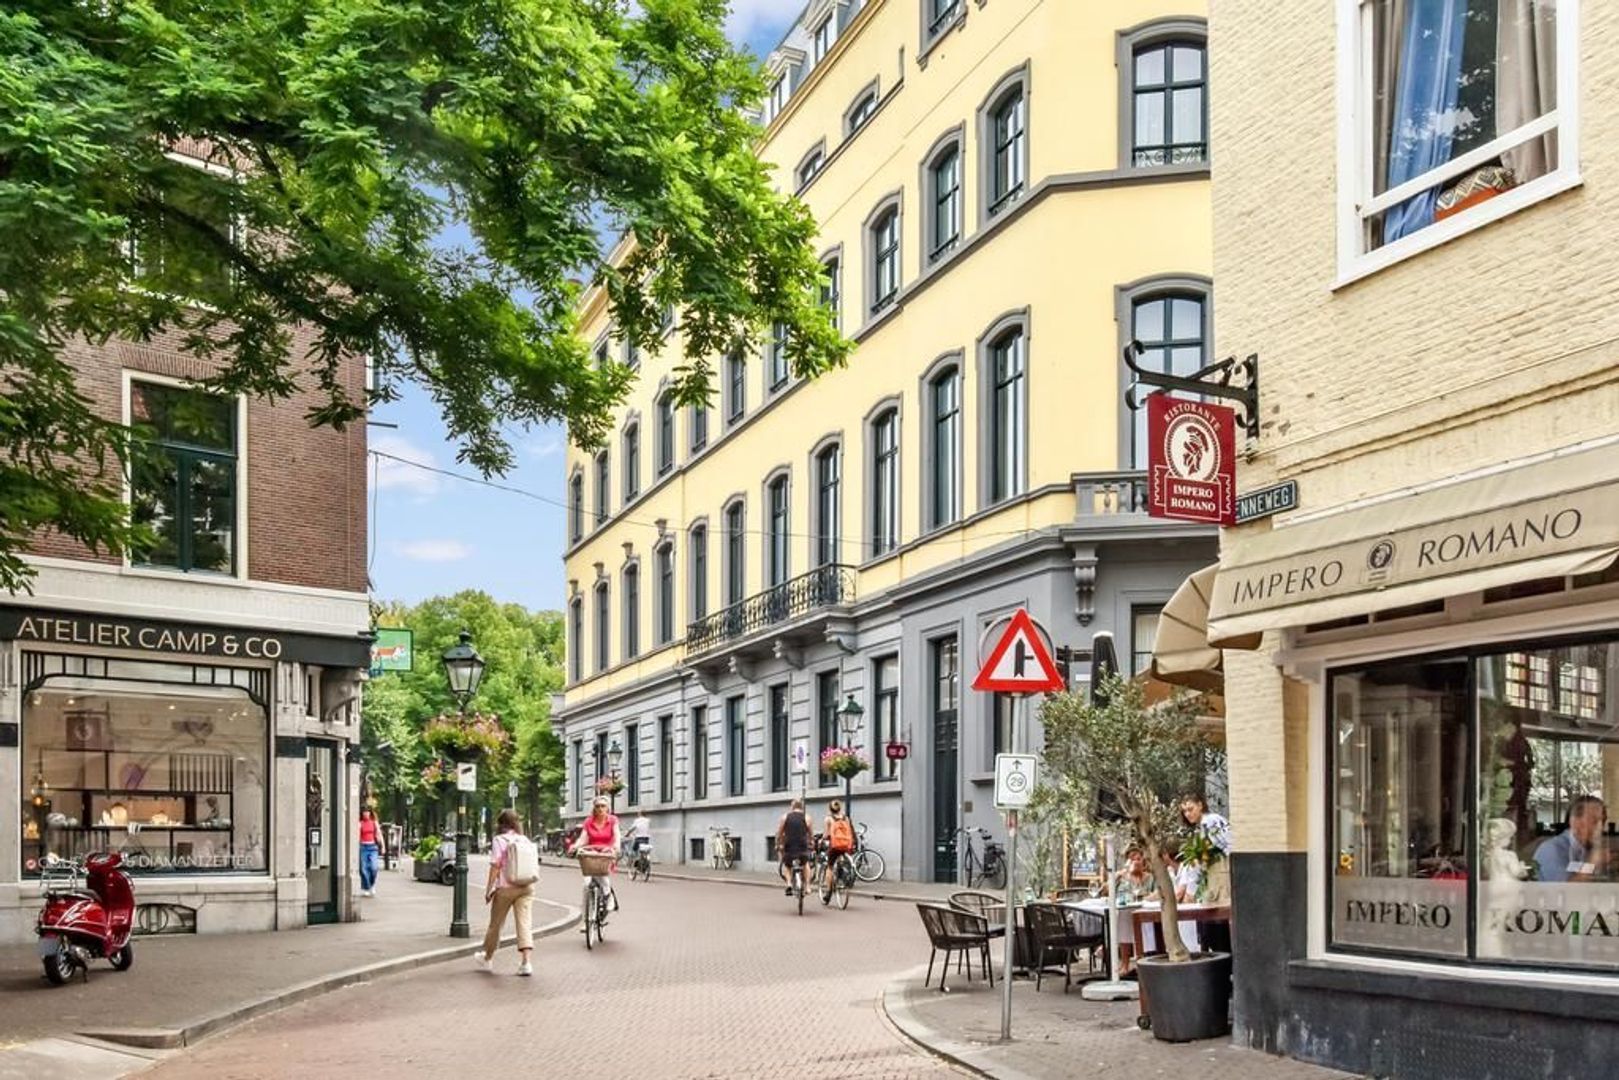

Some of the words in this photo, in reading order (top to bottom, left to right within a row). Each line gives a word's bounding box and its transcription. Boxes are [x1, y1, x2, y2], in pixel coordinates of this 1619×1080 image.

[1164, 403, 1221, 431] RISTORANTE
[1171, 497, 1216, 512] ROMANO
[1173, 484, 1214, 498] IMPERO
[1233, 560, 1343, 604] IMPERO
[1418, 508, 1582, 568] ROMANO
[17, 616, 131, 647] ATELIER
[138, 627, 216, 653] CAMP
[223, 635, 239, 655] &
[245, 637, 282, 659] CO
[139, 855, 254, 869] DIAMANTZETTER
[1346, 899, 1452, 929] IMPERO
